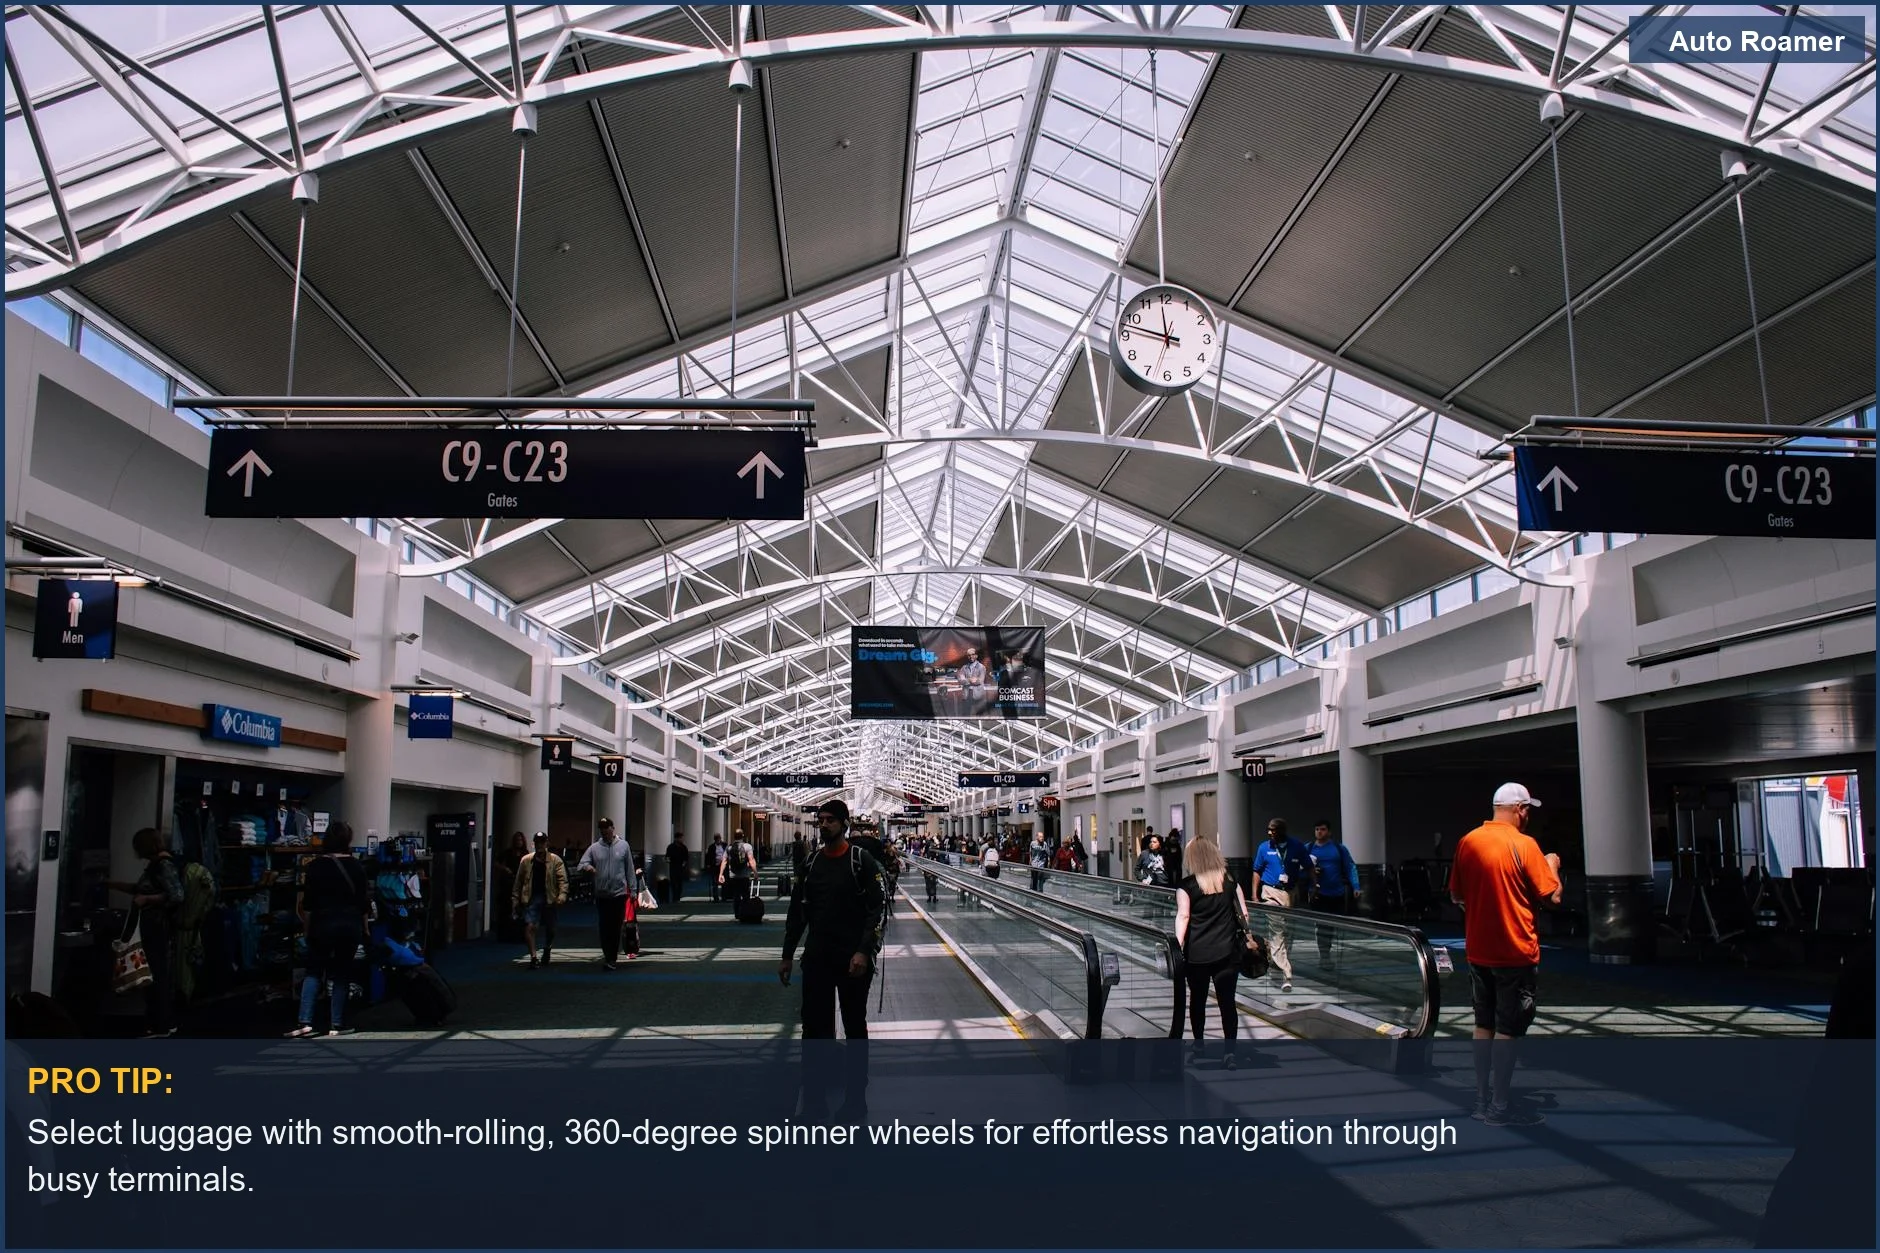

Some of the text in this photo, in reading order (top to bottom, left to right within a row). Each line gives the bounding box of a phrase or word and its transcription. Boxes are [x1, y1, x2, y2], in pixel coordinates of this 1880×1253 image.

[1139, 299, 1152, 310] 11
[1157, 294, 1173, 305] 12
[1183, 300, 1189, 311] 1
[1126, 314, 1141, 325] 10
[1196, 315, 1206, 326] 2
[1121, 330, 1130, 342] 9
[1202, 334, 1212, 345] 3
[1127, 350, 1137, 361] 8
[1197, 352, 1206, 363] 4
[1143, 365, 1152, 376] 7
[1183, 366, 1192, 377] 5
[1163, 371, 1172, 382] 6
[442, 440, 568, 483] C9-C23
[1724, 464, 1833, 506] C9-C23
[487, 492, 518, 508] Gates
[1767, 513, 1794, 528] Gates
[62, 630, 84, 644] Men
[858, 648, 907, 661] Dream
[998, 687, 1034, 695] COMCAST
[418, 712, 450, 721] Columbia
[232, 712, 276, 741] Columbia
[604, 762, 618, 777] C9
[1245, 763, 1264, 777] C10
[993, 774, 1016, 783] C11-C23
